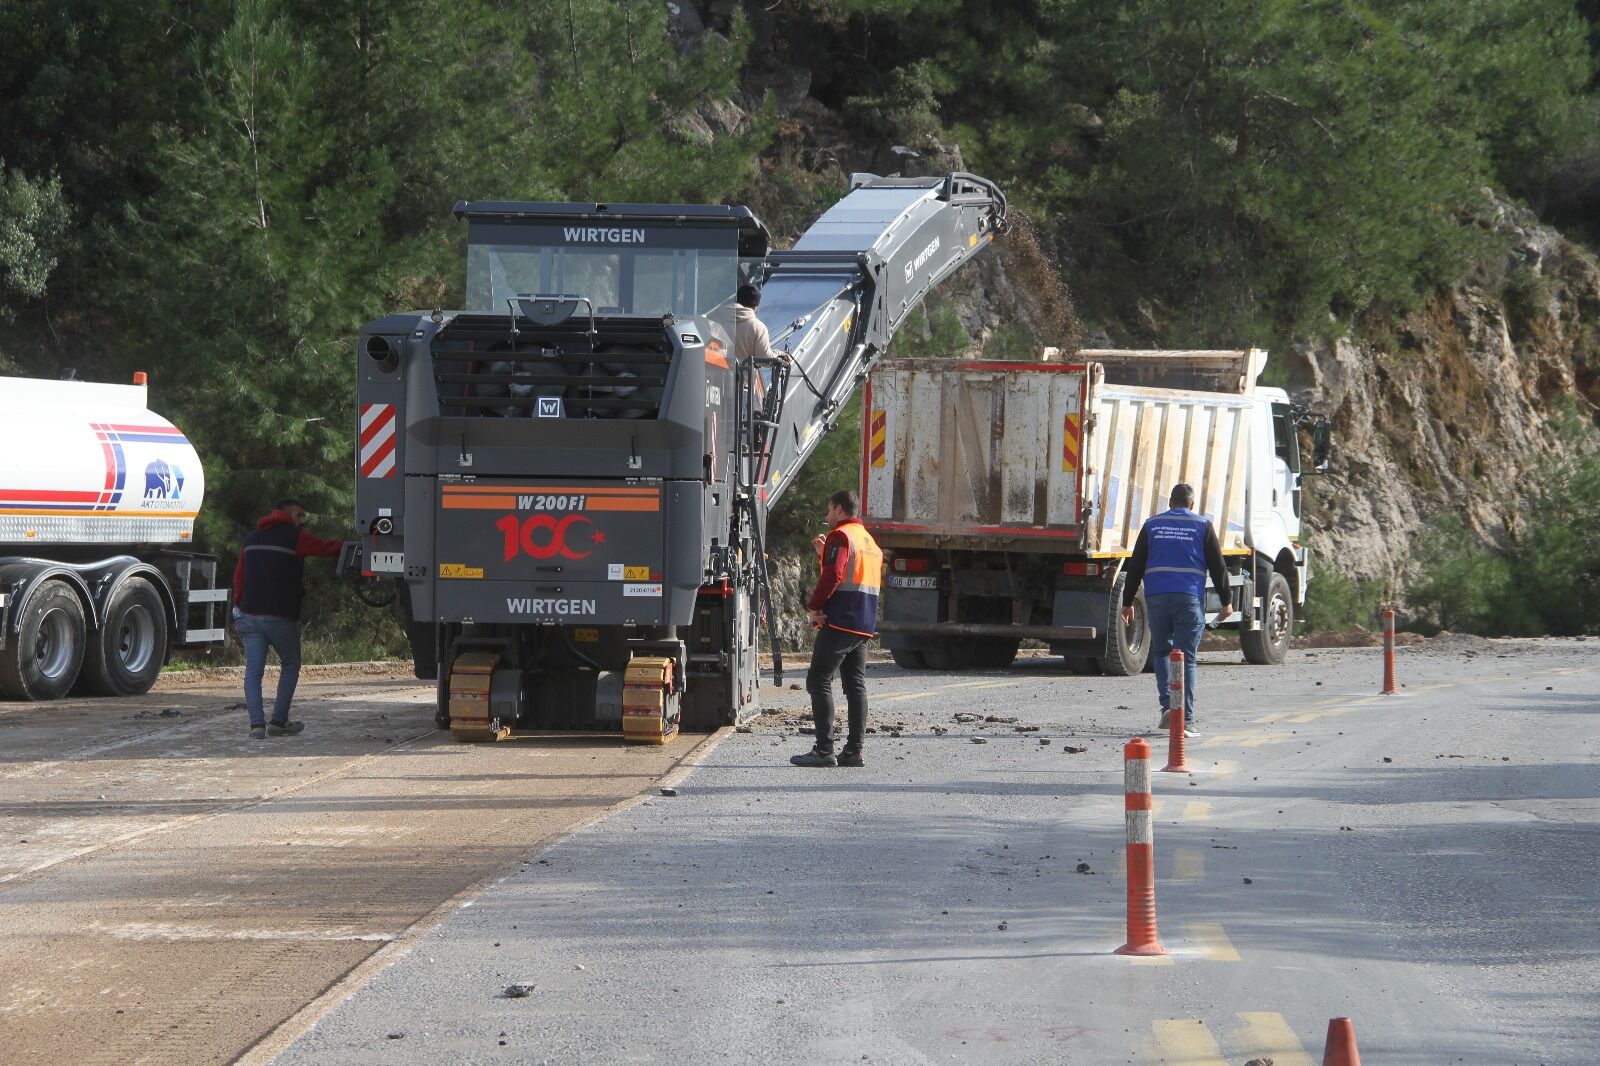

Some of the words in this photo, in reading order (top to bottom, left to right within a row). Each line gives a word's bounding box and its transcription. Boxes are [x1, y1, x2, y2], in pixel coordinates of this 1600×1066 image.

[564, 227, 645, 243] WIRTGEN
[913, 236, 940, 271] WIRTGEN
[141, 500, 155, 509] AKT
[506, 598, 596, 615] WIRTGEN
